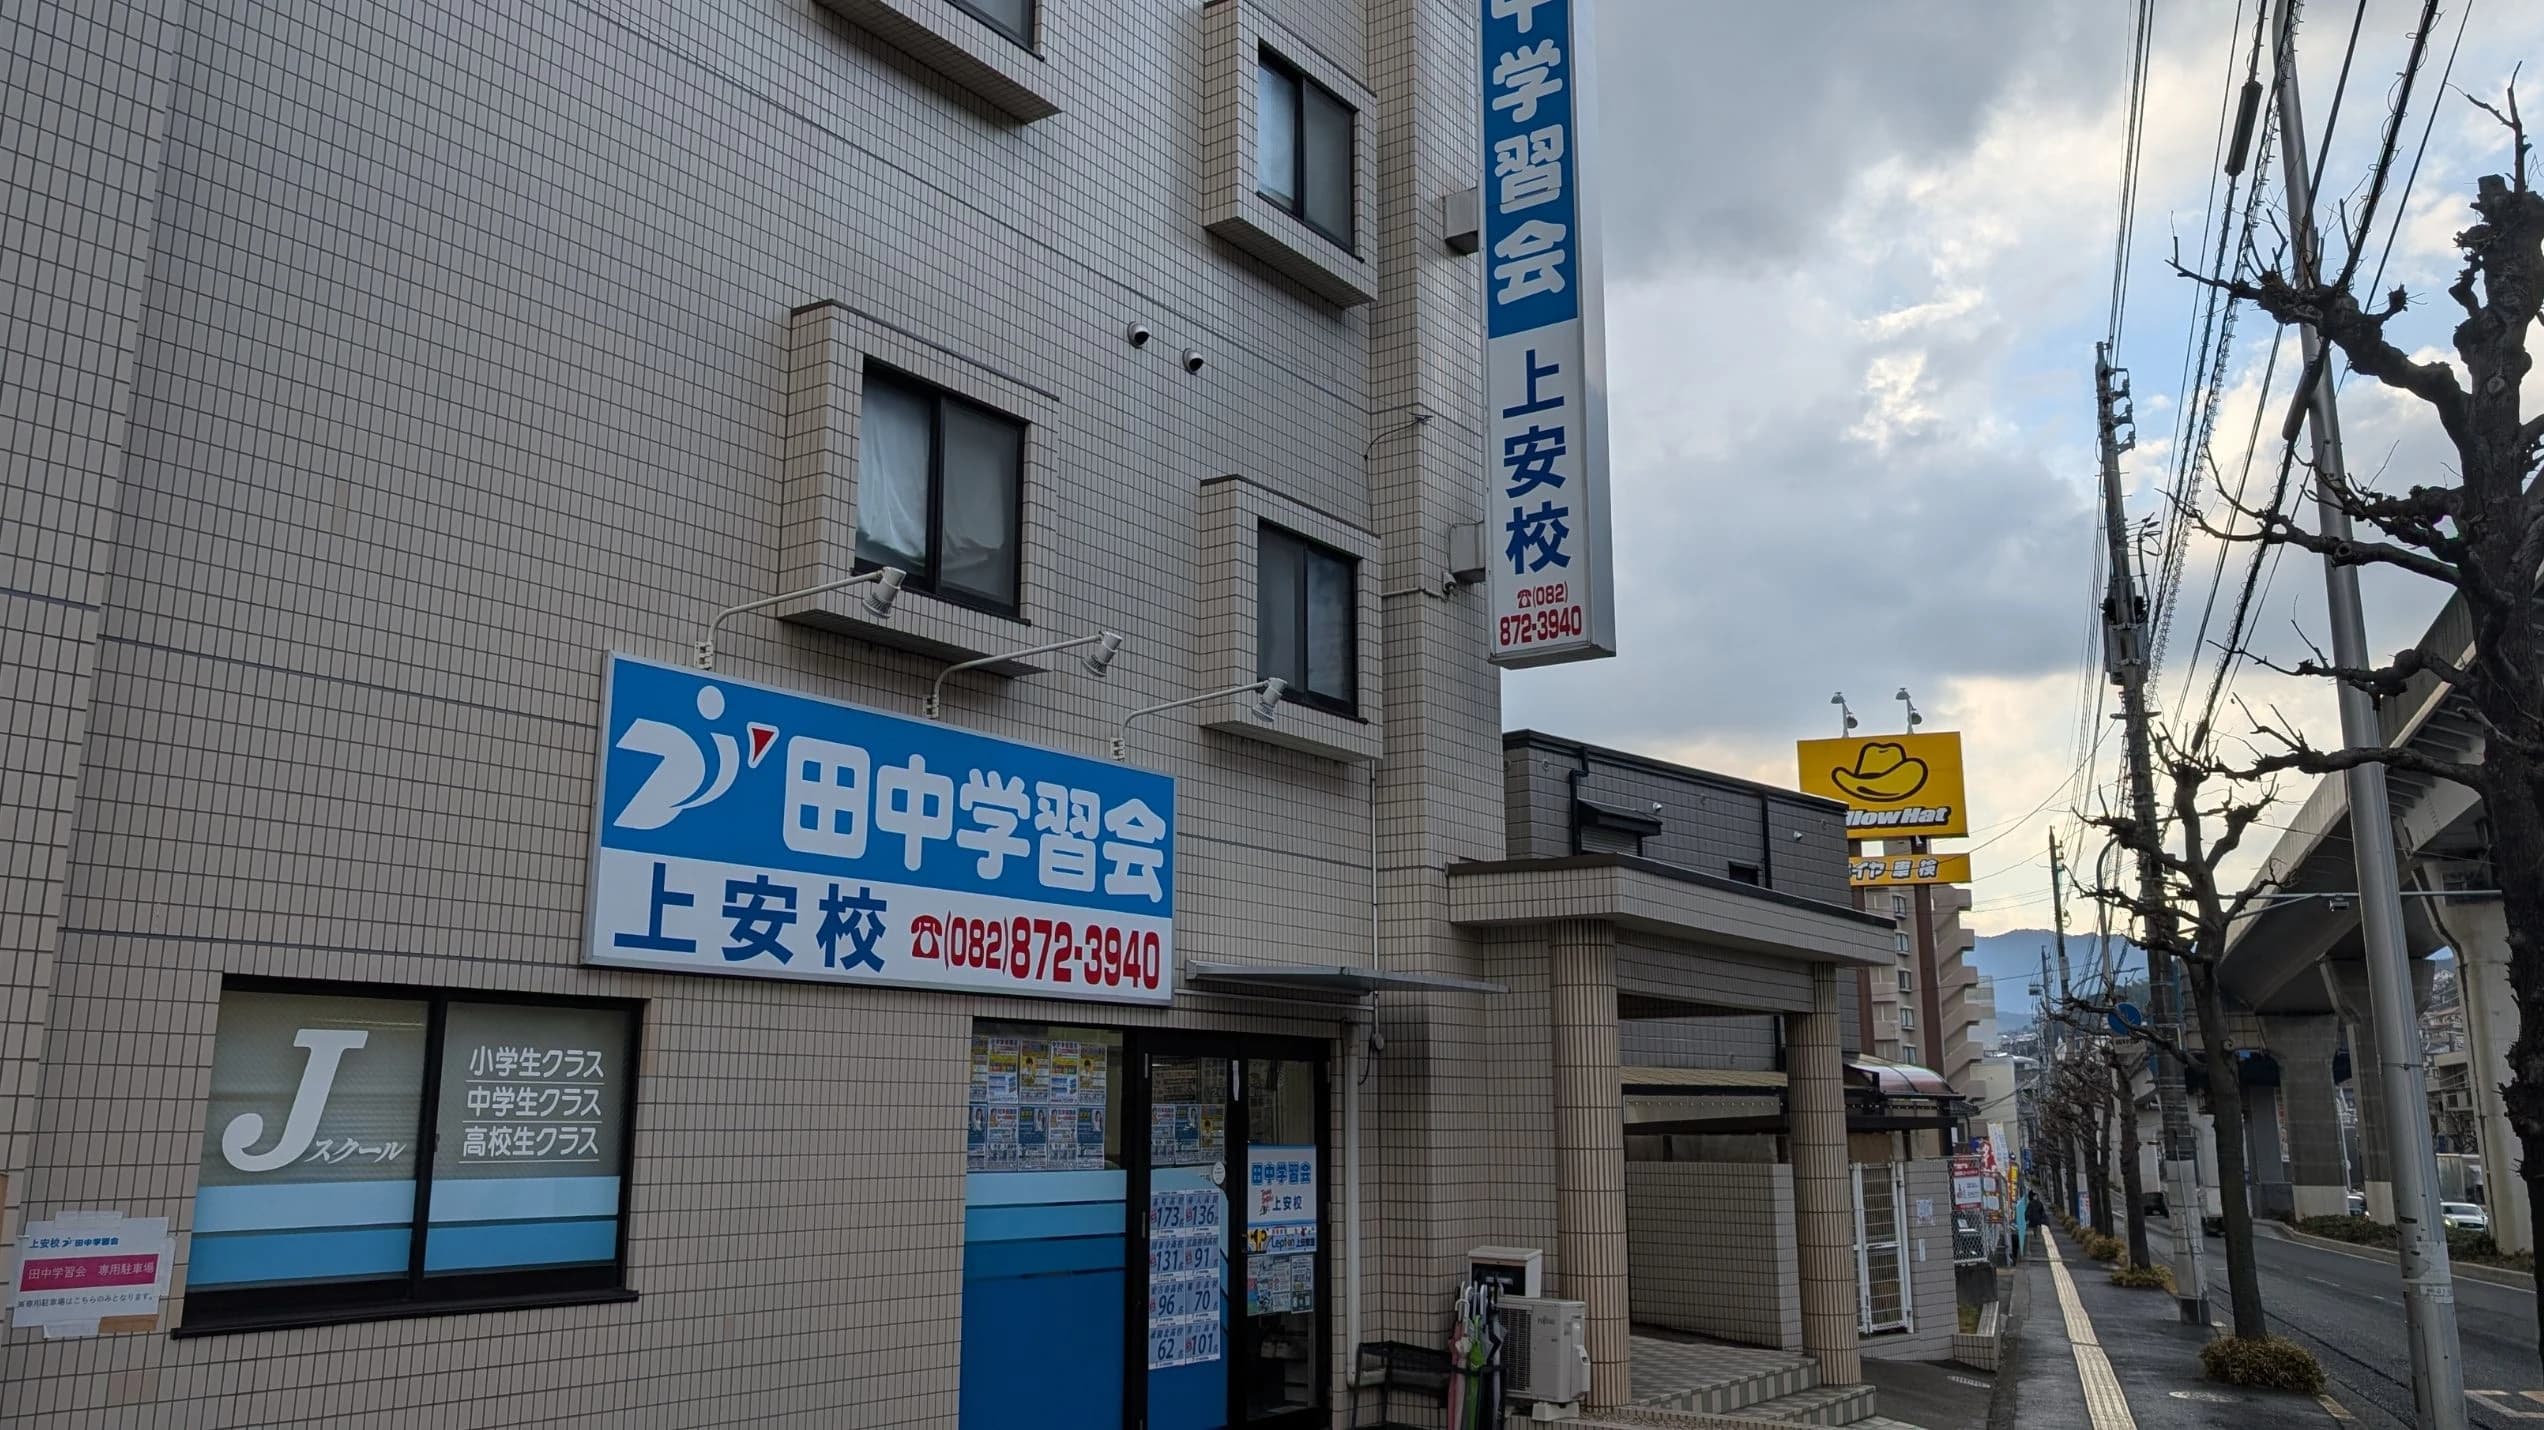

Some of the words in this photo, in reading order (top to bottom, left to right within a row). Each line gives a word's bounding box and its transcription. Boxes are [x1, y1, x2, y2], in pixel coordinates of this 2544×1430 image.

[1502, 349, 1571, 575] 上安校
[1532, 581, 1568, 606] (082)
[1500, 605, 1582, 646] 872-3940
[783, 735, 1166, 904] 田中学習会
[613, 861, 888, 975] 上安校
[469, 1045, 604, 1078] 小学生クラス
[467, 1085, 601, 1117] 中学生クラス
[463, 1126, 599, 1158] 高校生クラス
[1251, 1162, 1312, 1185] 田中学習会
[1272, 1195, 1303, 1212] 上安校
[30, 1238, 60, 1249] 上安校
[75, 1236, 119, 1247] 田中学習会
[28, 1265, 88, 1281] 田中学習会
[98, 1261, 155, 1276] 専用駐車場
